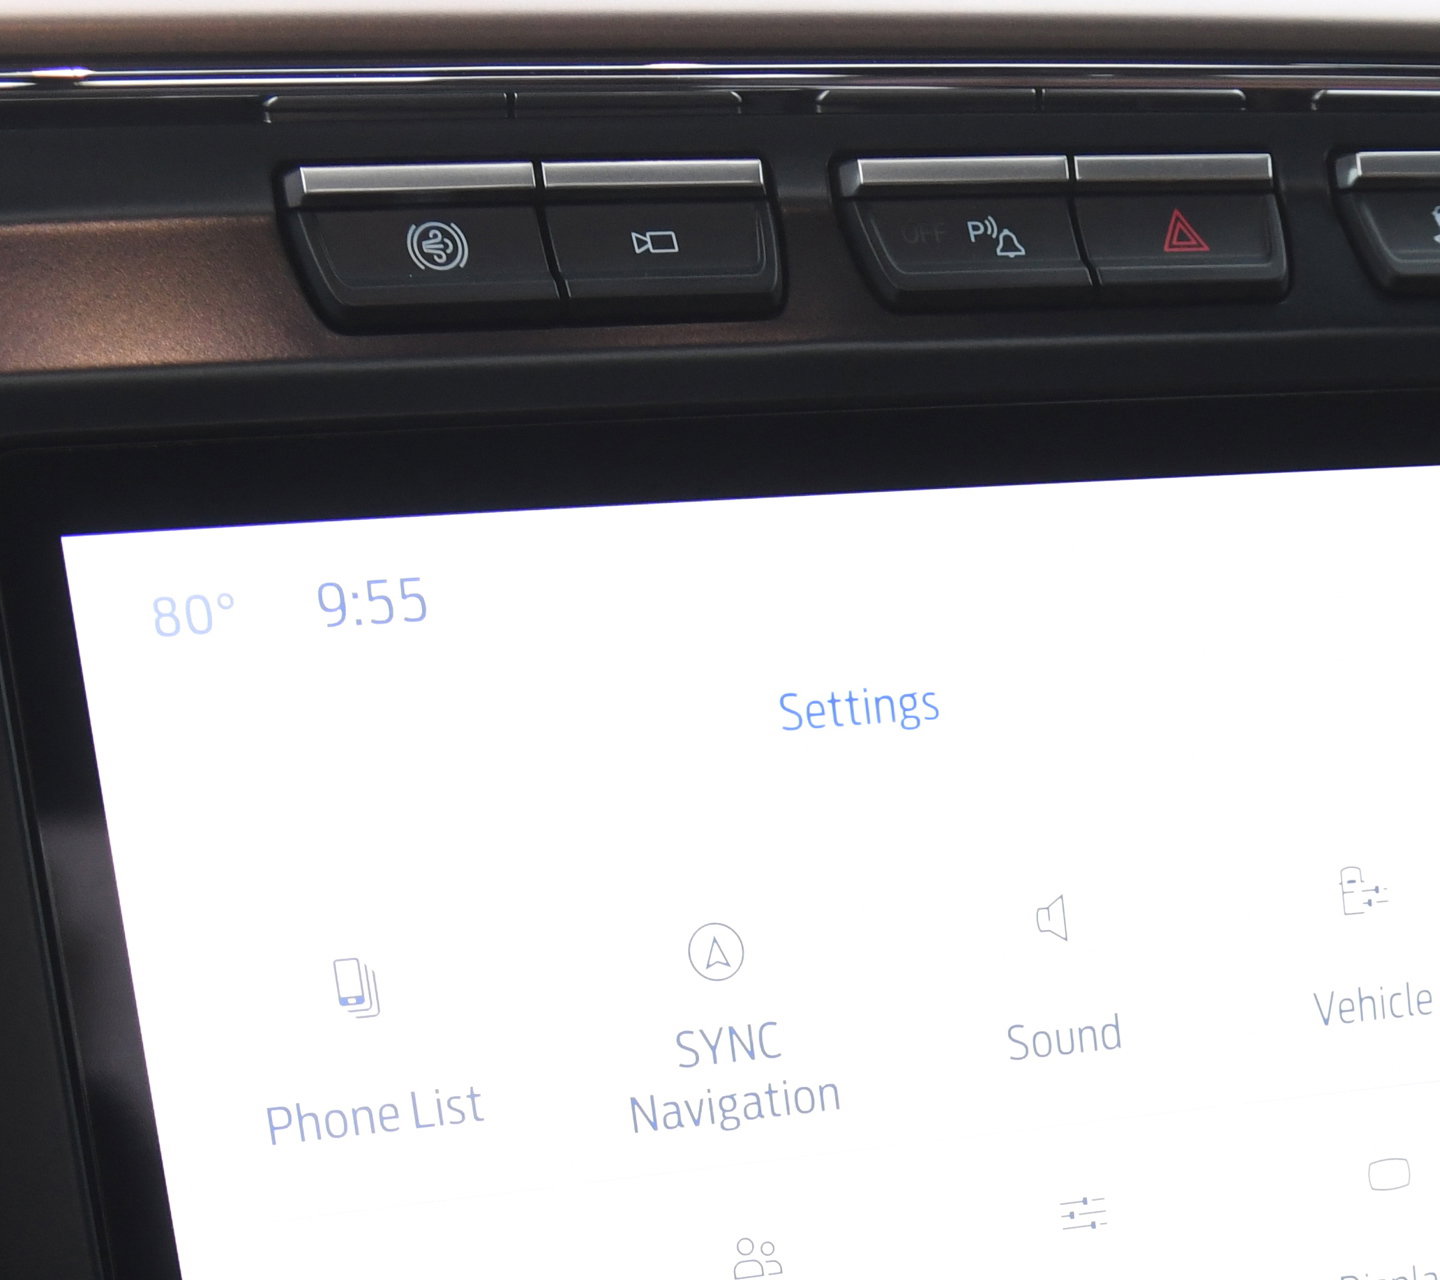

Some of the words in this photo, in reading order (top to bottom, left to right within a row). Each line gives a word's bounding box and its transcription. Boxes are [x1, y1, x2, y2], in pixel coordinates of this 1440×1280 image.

[153, 593, 234, 637] 80°
[318, 577, 426, 627] 9:55
[780, 688, 939, 731] Settings
[1313, 982, 1432, 1026] Vehicle
[676, 1022, 781, 1068] SYNC
[1008, 1013, 1121, 1060] Sound
[267, 1103, 400, 1145] Phone
[411, 1086, 484, 1128] List
[630, 1080, 840, 1133] Navigation
